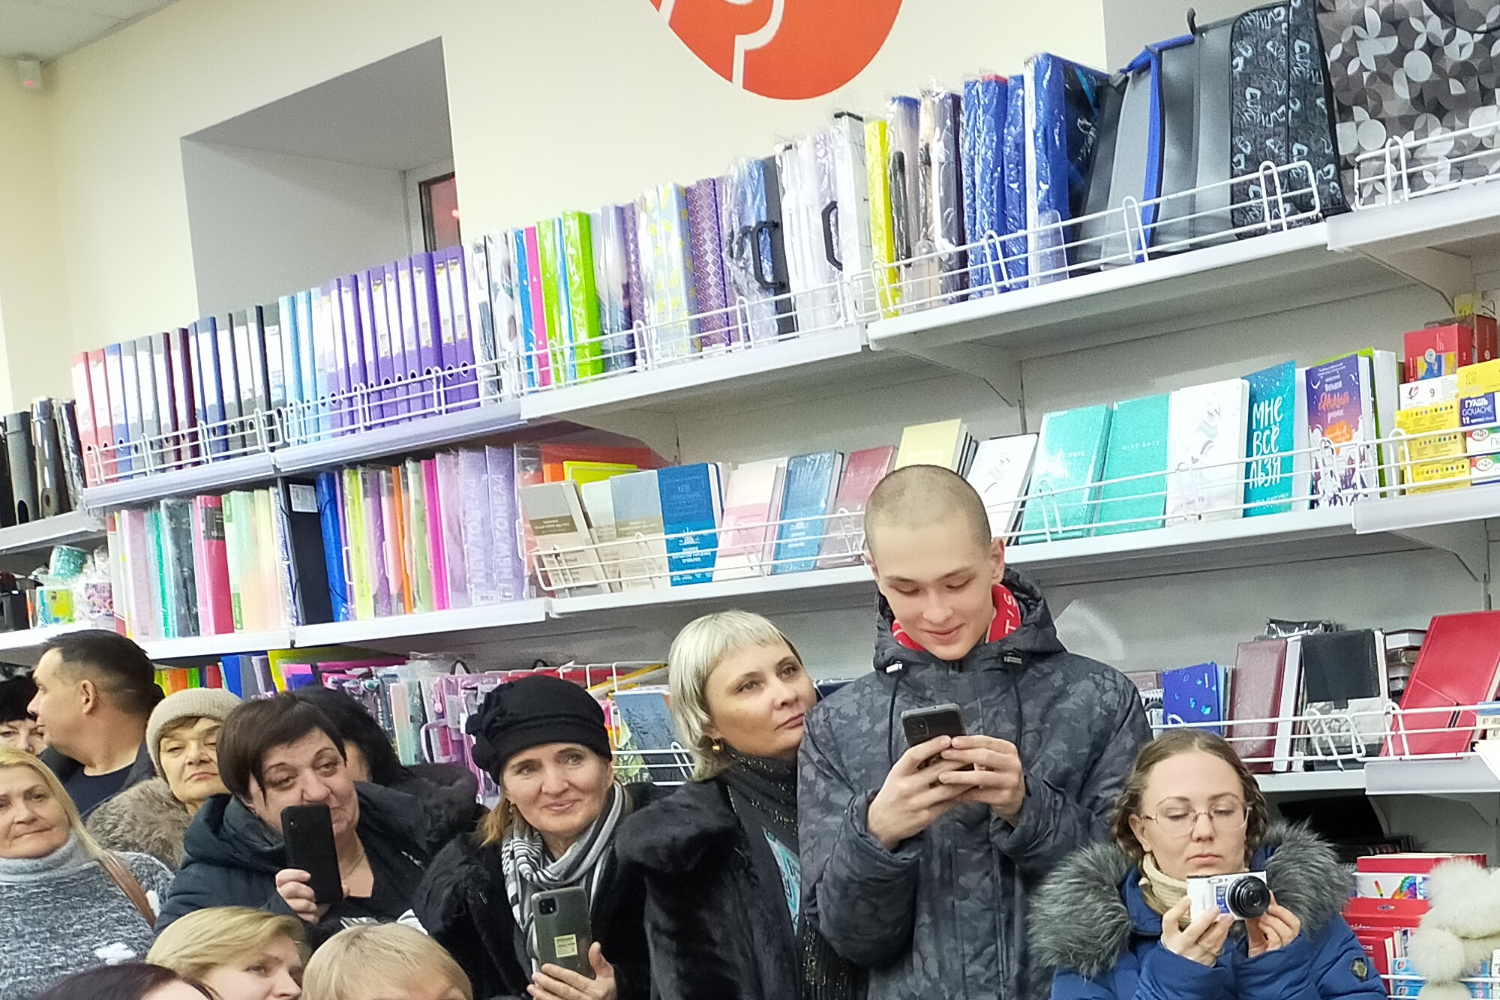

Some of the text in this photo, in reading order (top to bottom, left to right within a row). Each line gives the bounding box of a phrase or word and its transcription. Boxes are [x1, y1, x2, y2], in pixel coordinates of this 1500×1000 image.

[1430, 388, 1435, 398] 9
[1465, 398, 1489, 408] ГУАШЬ
[1462, 405, 1493, 416] GOUACHE
